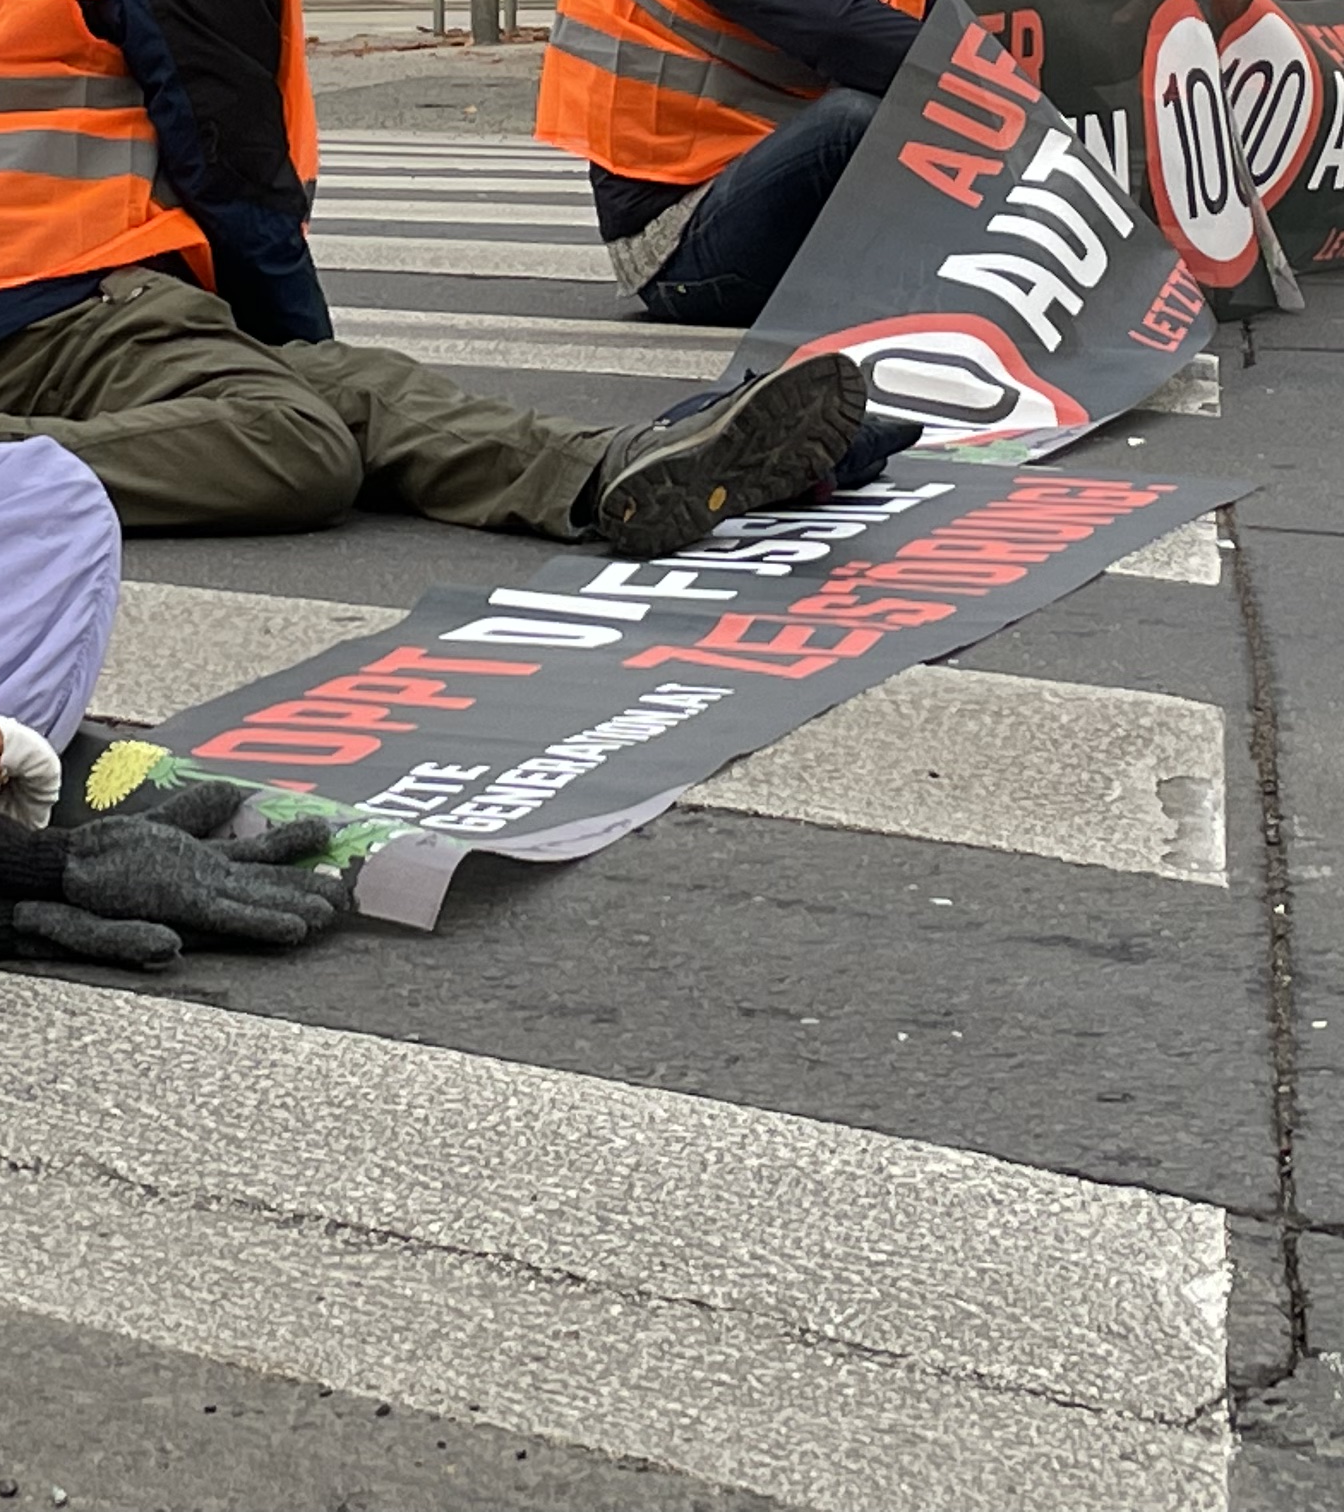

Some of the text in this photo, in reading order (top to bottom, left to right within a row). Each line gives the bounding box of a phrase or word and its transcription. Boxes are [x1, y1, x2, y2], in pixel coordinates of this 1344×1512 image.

[898, 22, 1042, 209] AUF
[936, 127, 1135, 353] AUT
[192, 646, 542, 767] OPPT
